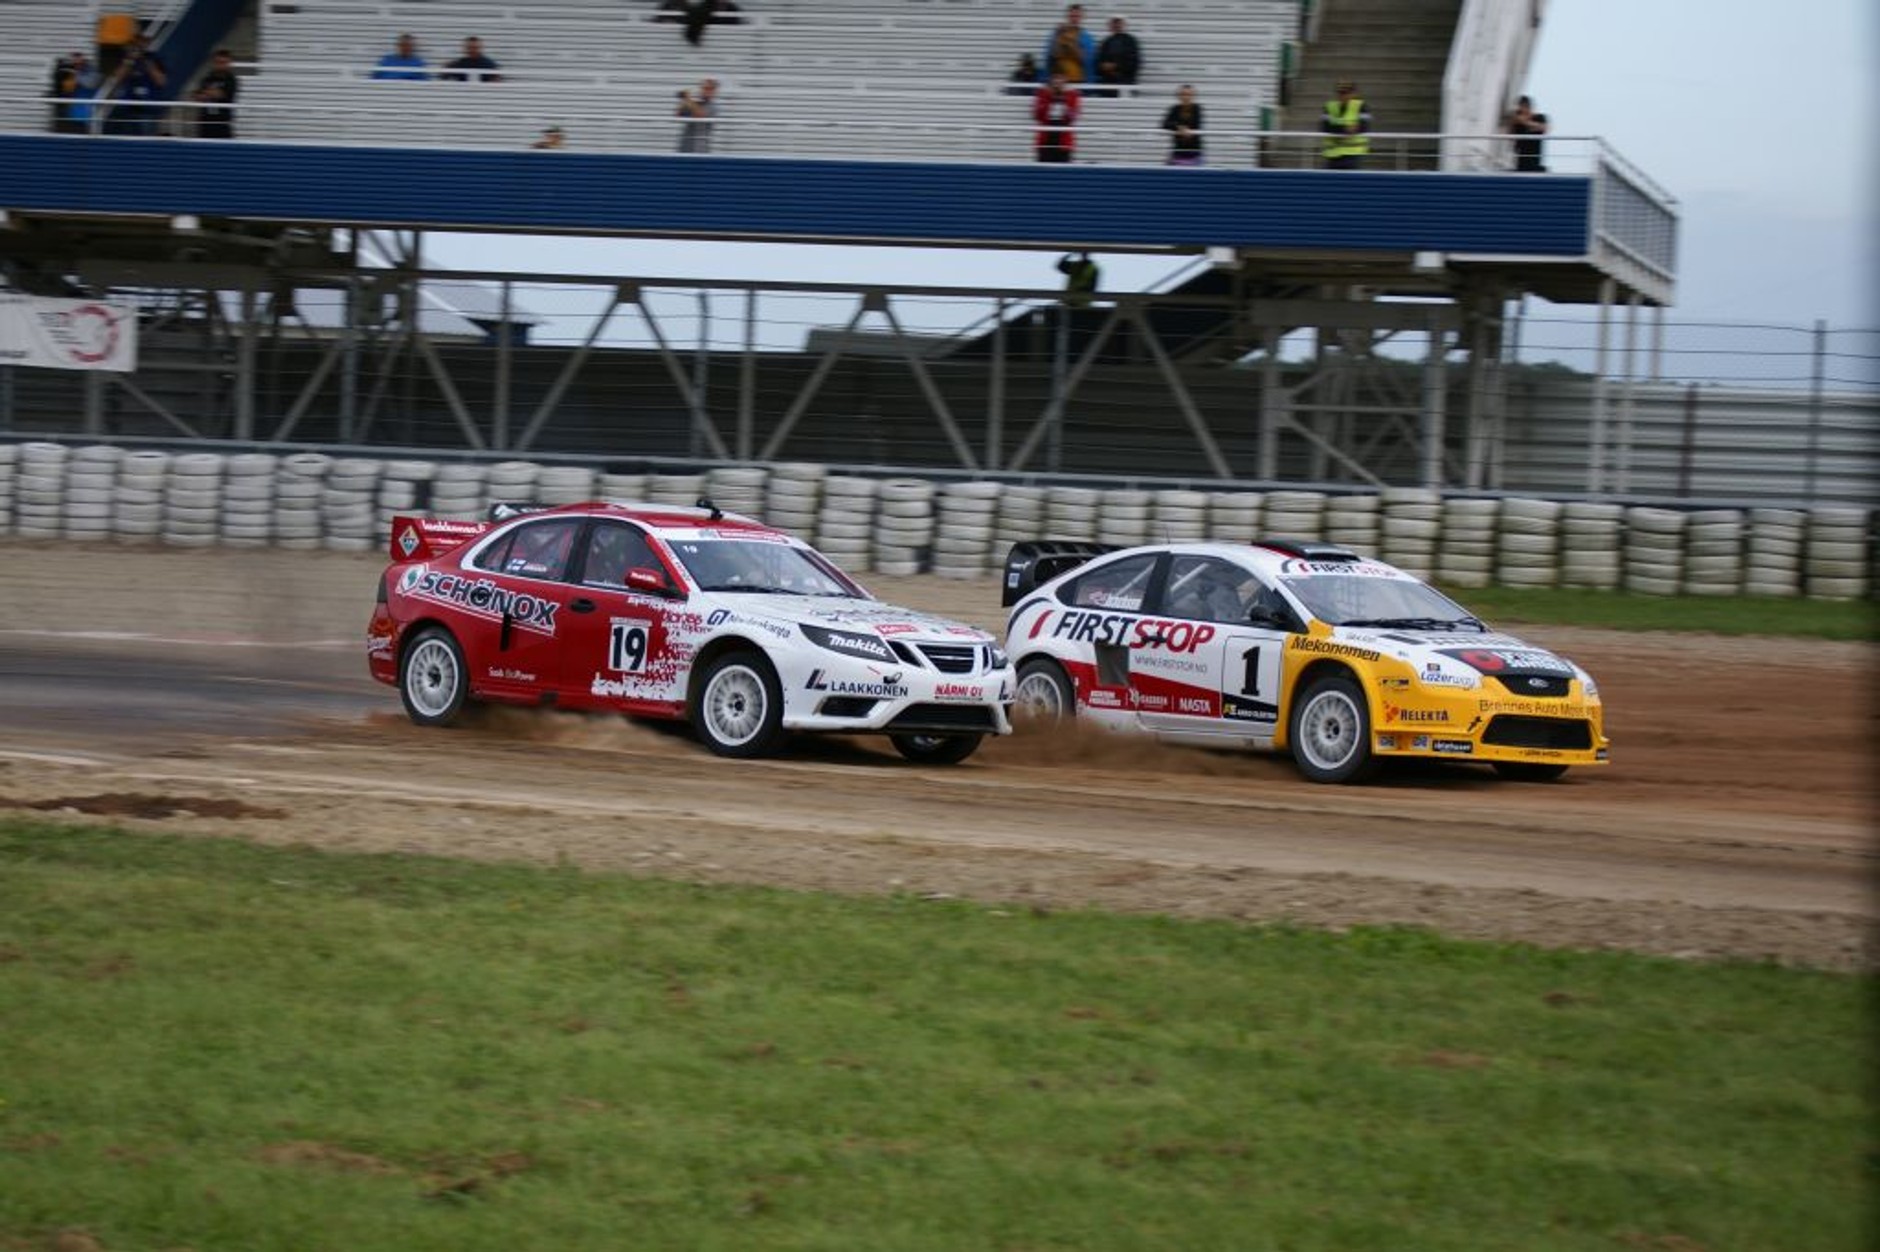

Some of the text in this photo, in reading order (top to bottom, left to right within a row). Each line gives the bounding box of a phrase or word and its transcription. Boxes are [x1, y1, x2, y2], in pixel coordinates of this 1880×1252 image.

[418, 569, 560, 627] SCHÖNOX
[612, 626, 646, 671] 19
[1291, 636, 1381, 662] Mekonomen
[831, 680, 909, 698] LAAKKONEN
[1241, 646, 1261, 697] 1
[1401, 708, 1449, 721] RELEKTA
